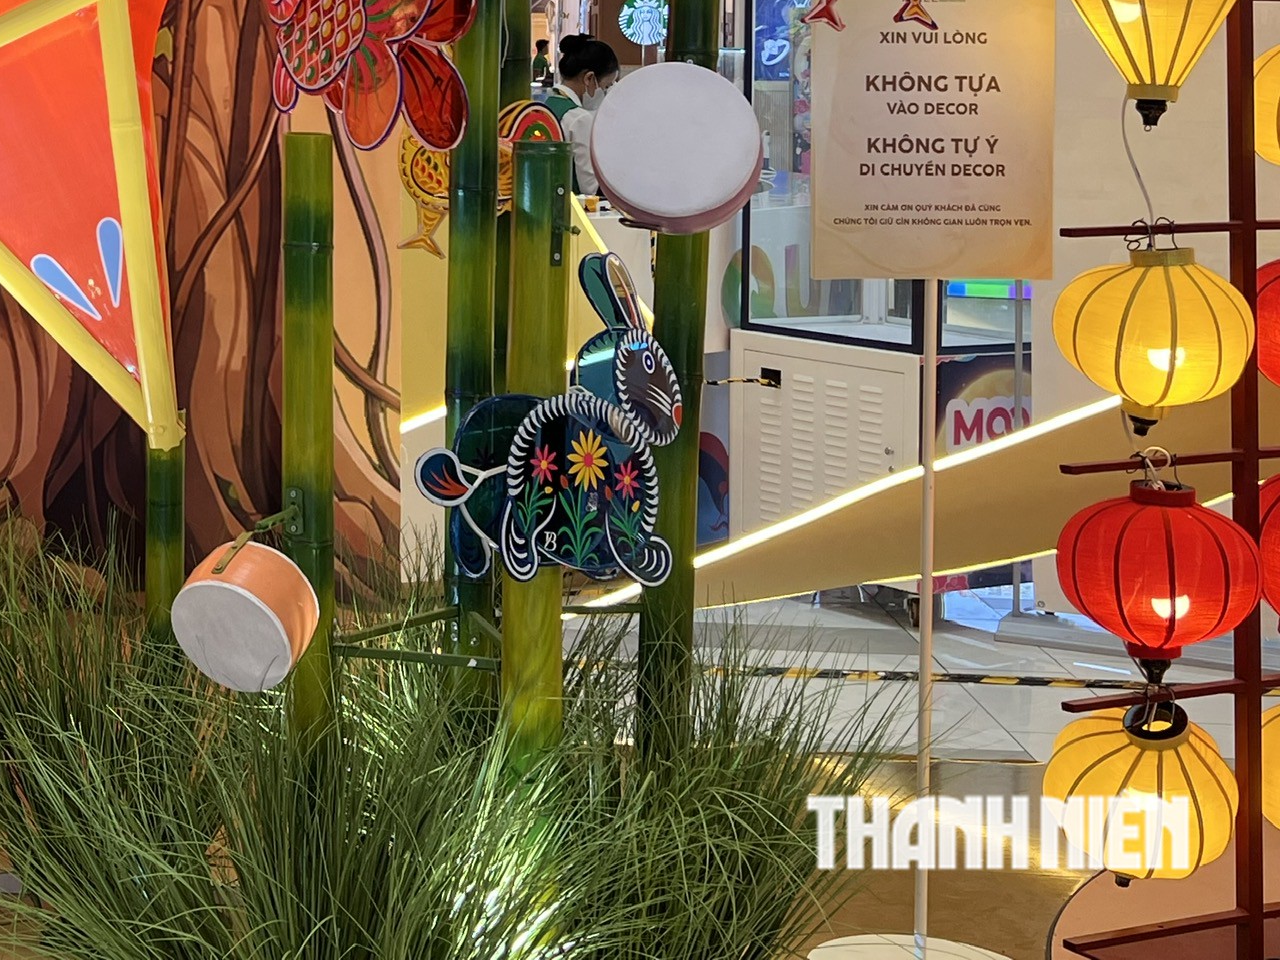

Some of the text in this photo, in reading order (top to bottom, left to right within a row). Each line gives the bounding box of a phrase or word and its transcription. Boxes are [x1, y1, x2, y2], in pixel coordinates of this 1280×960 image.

[879, 29, 988, 44] XIN VUI LÒNG
[866, 71, 1001, 97] KHÔNG TỰA
[886, 100, 978, 115] VÀO DECOR
[866, 133, 999, 158] KHÔNG TỰ Ý
[860, 163, 875, 176] DI
[951, 164, 1006, 176] DECOR
[864, 204, 878, 212] XIN
[934, 203, 963, 212] KHÁCH
[864, 216, 878, 225] TÔI
[911, 217, 942, 226] KHÔNG
[944, 218, 964, 226] GIAN
[964, 217, 988, 226] LUÔN
